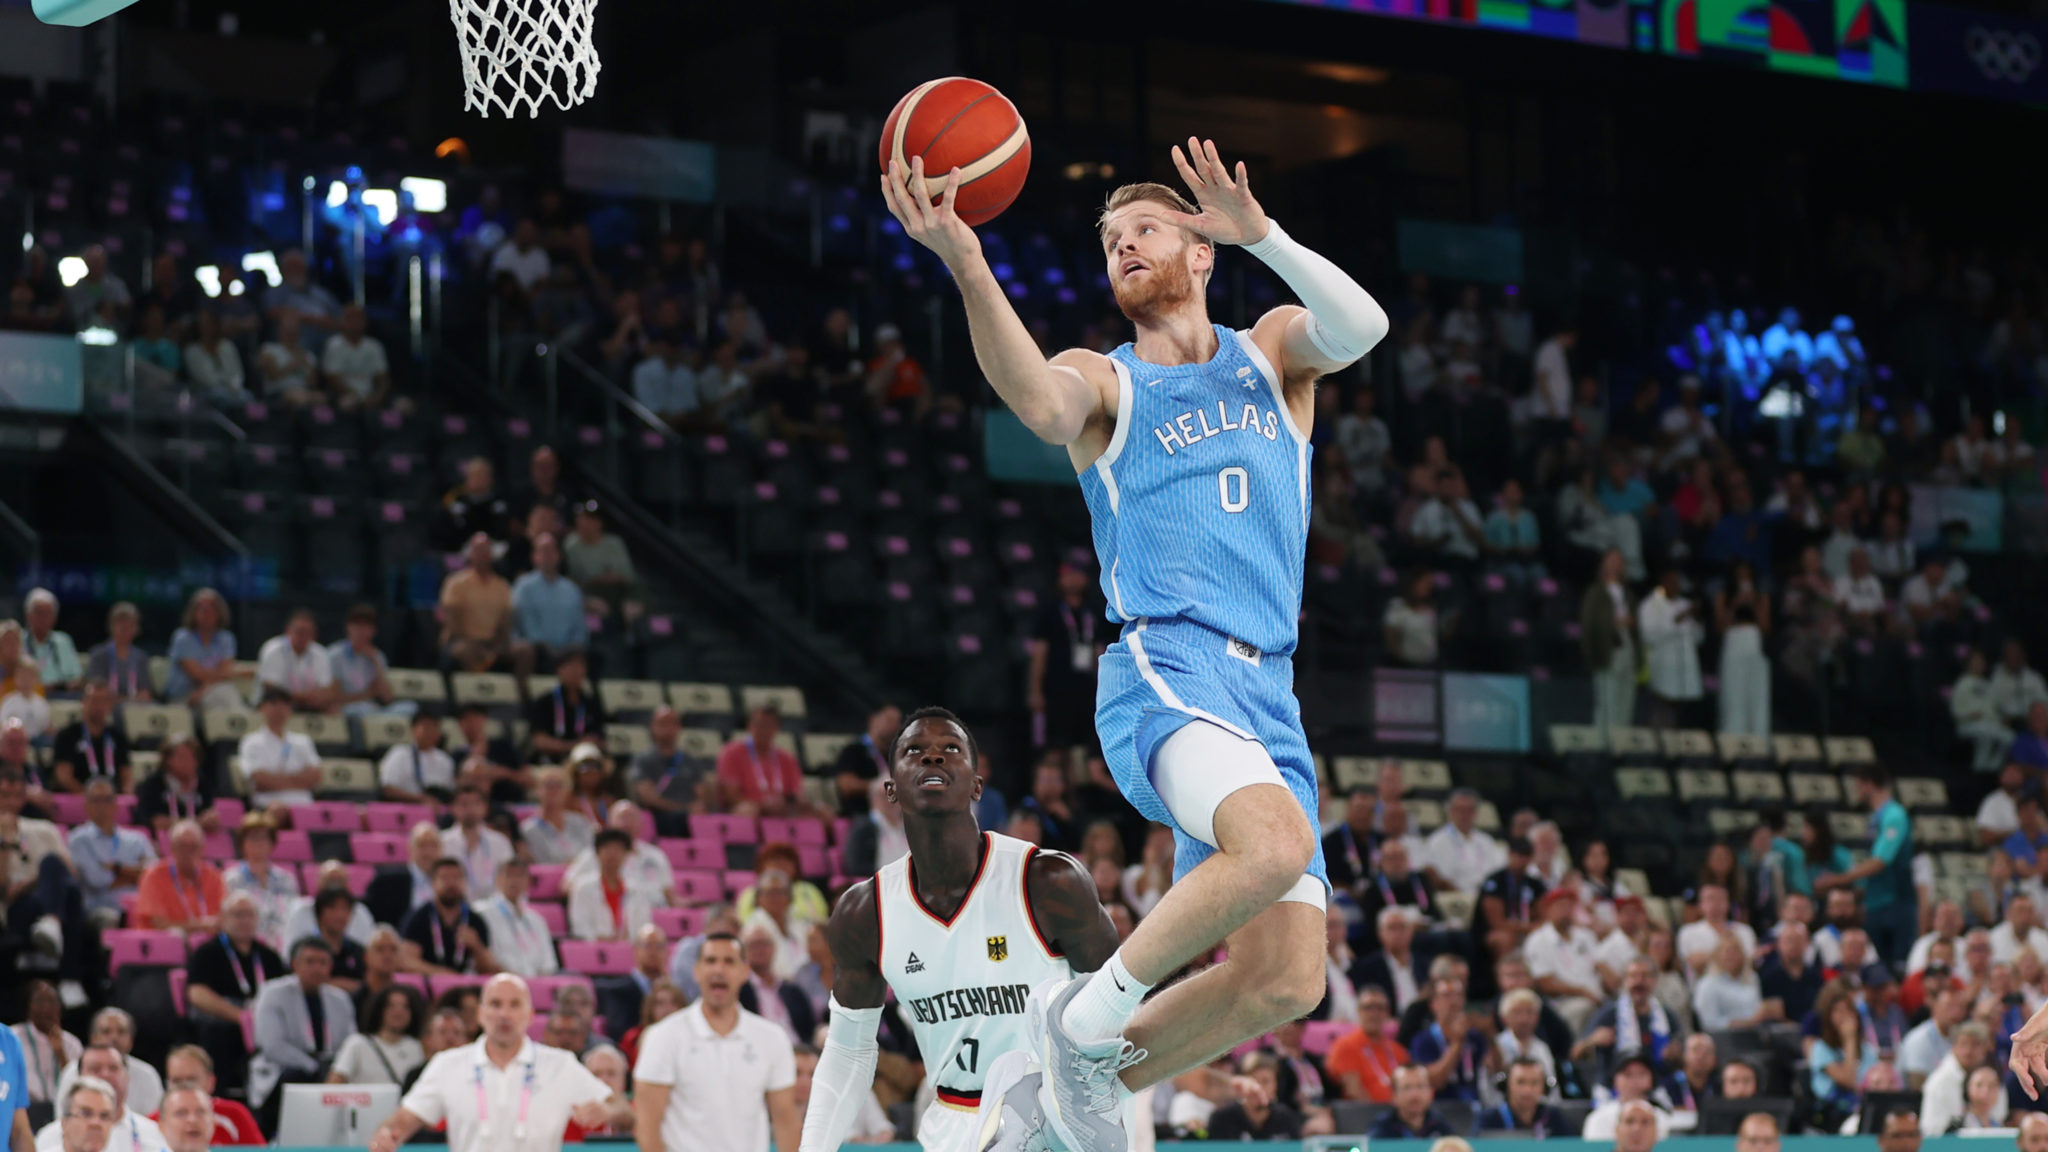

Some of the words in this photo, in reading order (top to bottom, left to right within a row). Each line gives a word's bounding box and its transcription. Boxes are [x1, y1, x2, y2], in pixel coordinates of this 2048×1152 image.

[1154, 400, 1278, 456] HELLAS
[1217, 466, 1250, 514] 0
[905, 961, 926, 974] PEAK
[908, 984, 1030, 1025] DEUTSCHLAND
